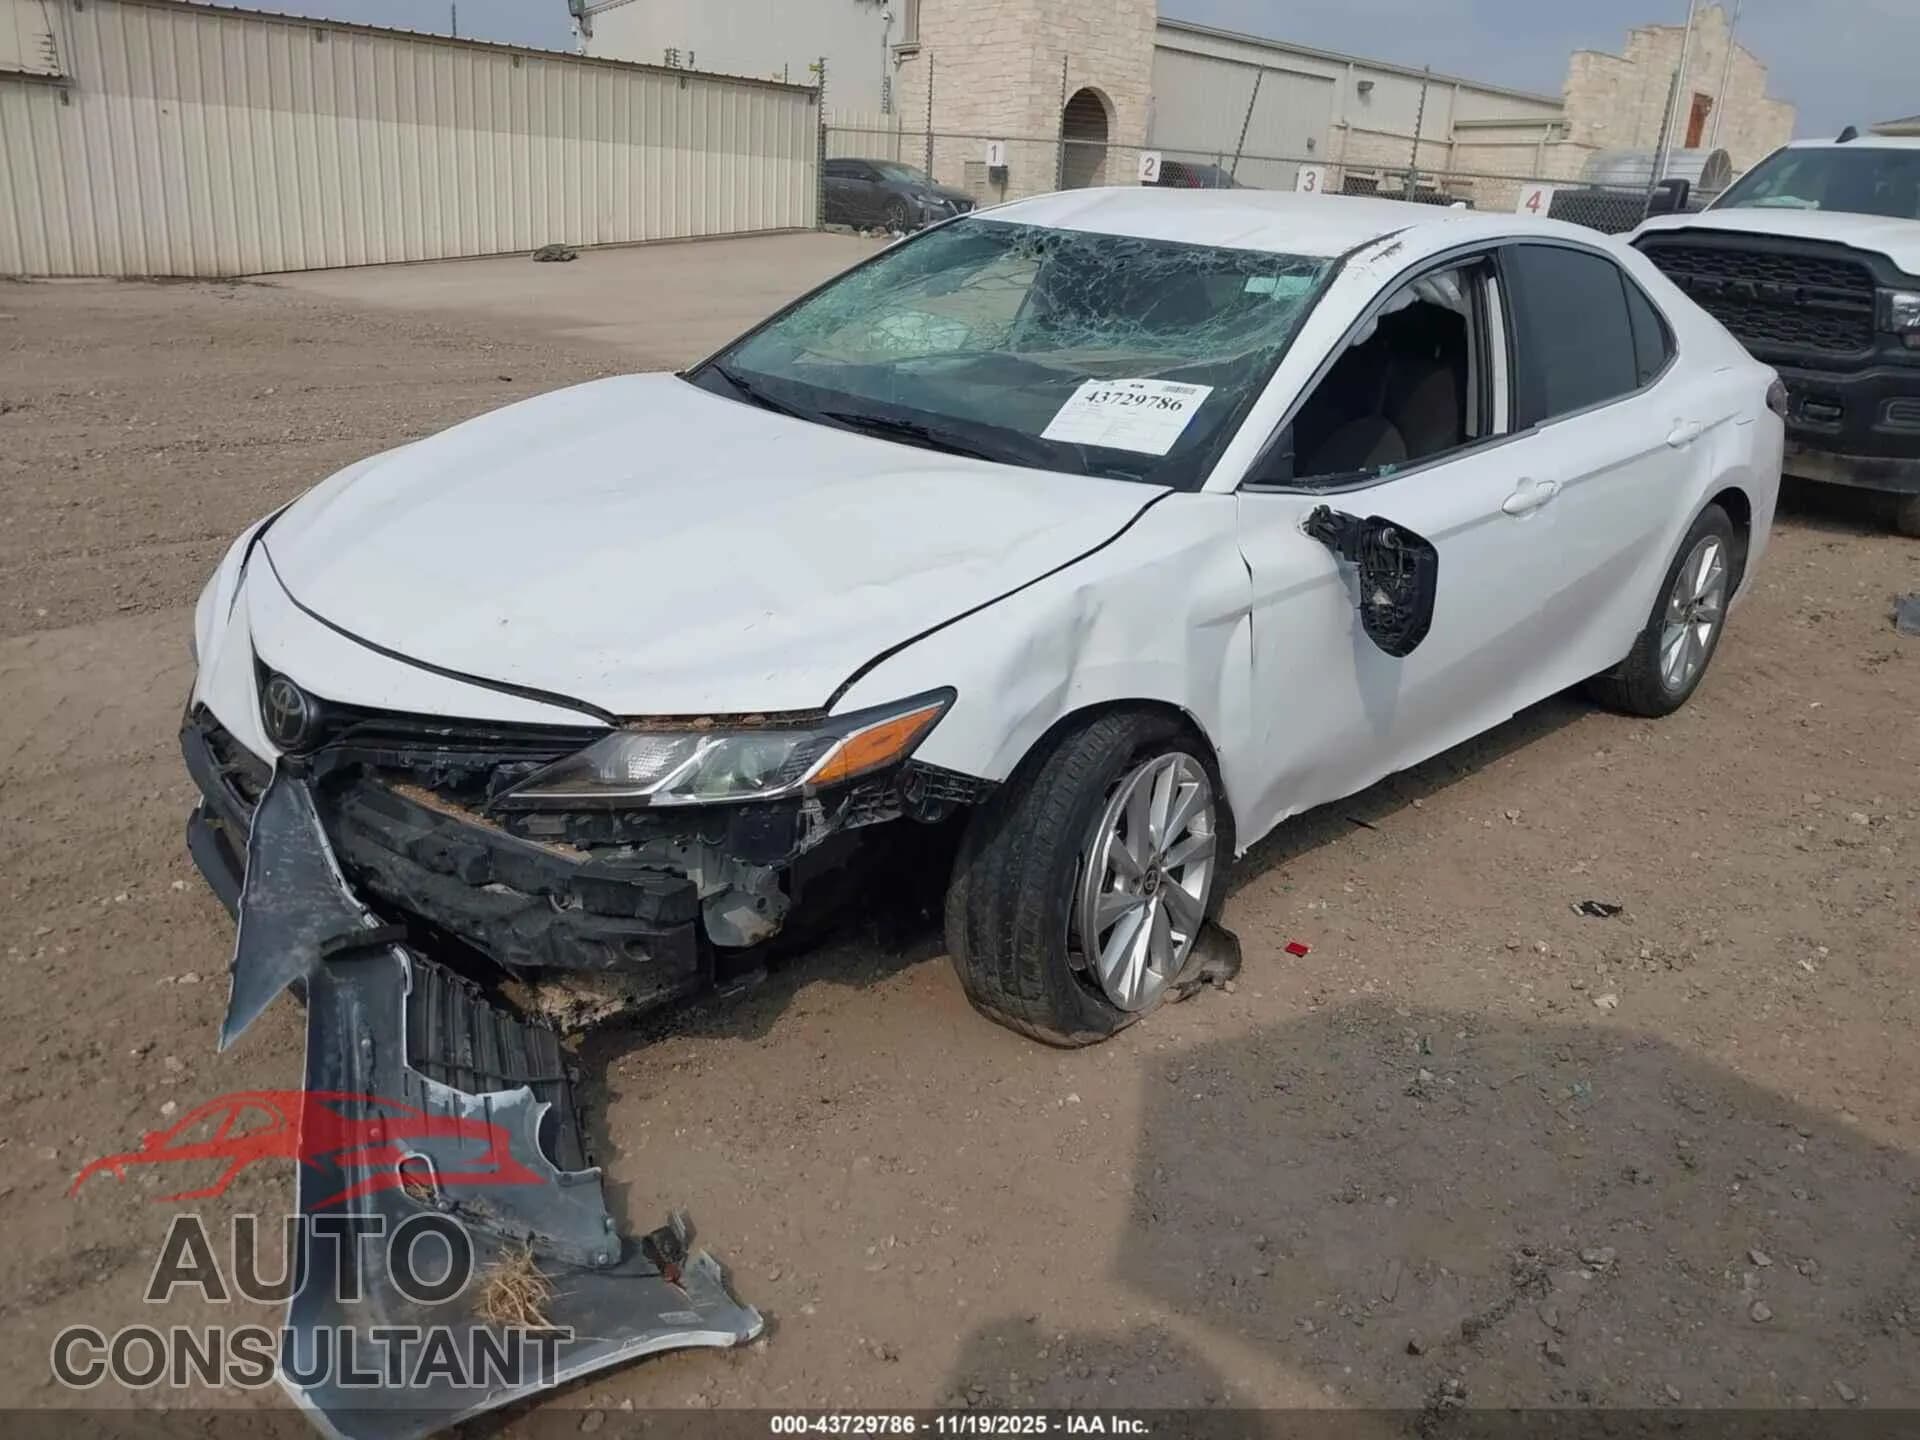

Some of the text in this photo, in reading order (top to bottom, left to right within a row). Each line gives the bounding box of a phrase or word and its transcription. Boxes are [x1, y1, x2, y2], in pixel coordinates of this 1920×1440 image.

[1143, 157, 1155, 177] 2
[1303, 171, 1316, 192] 3
[1525, 191, 1542, 214] 4
[1085, 390, 1183, 412] 43729786
